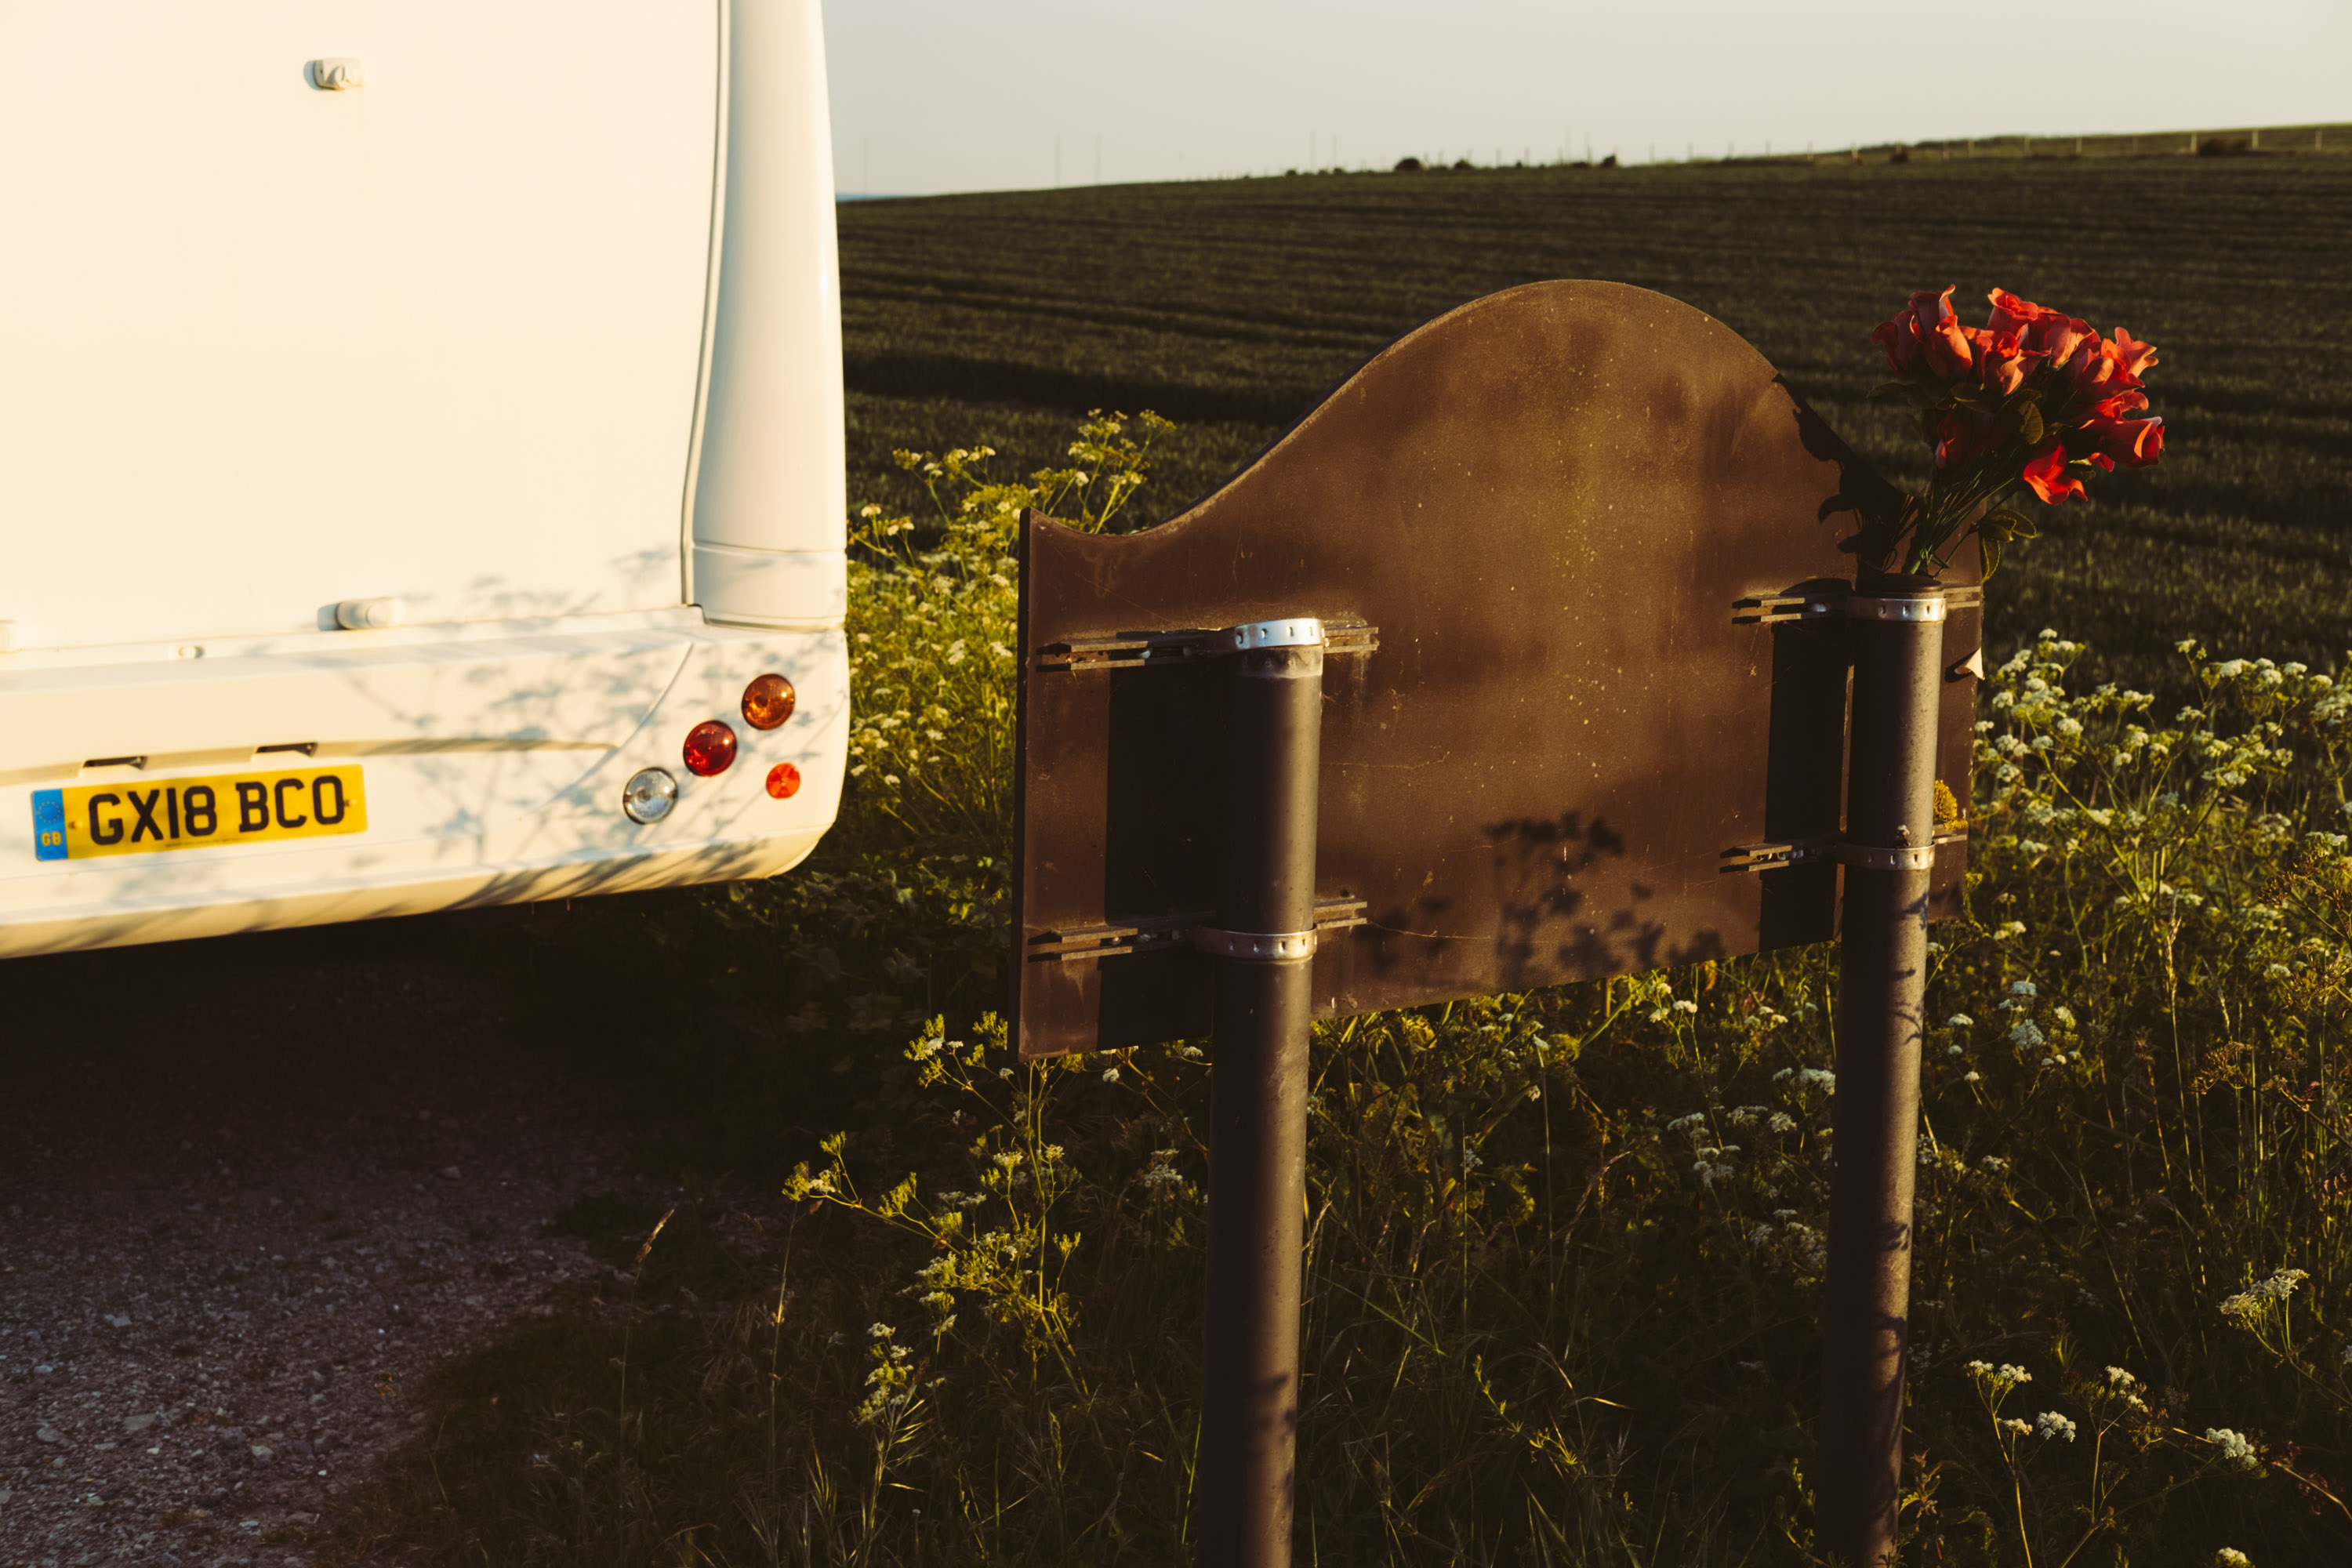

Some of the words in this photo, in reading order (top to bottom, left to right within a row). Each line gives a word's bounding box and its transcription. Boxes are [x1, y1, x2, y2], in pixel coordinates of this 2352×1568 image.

[88, 786, 218, 846] GX18
[235, 775, 345, 833] BCO
[42, 831, 61, 846] GB
